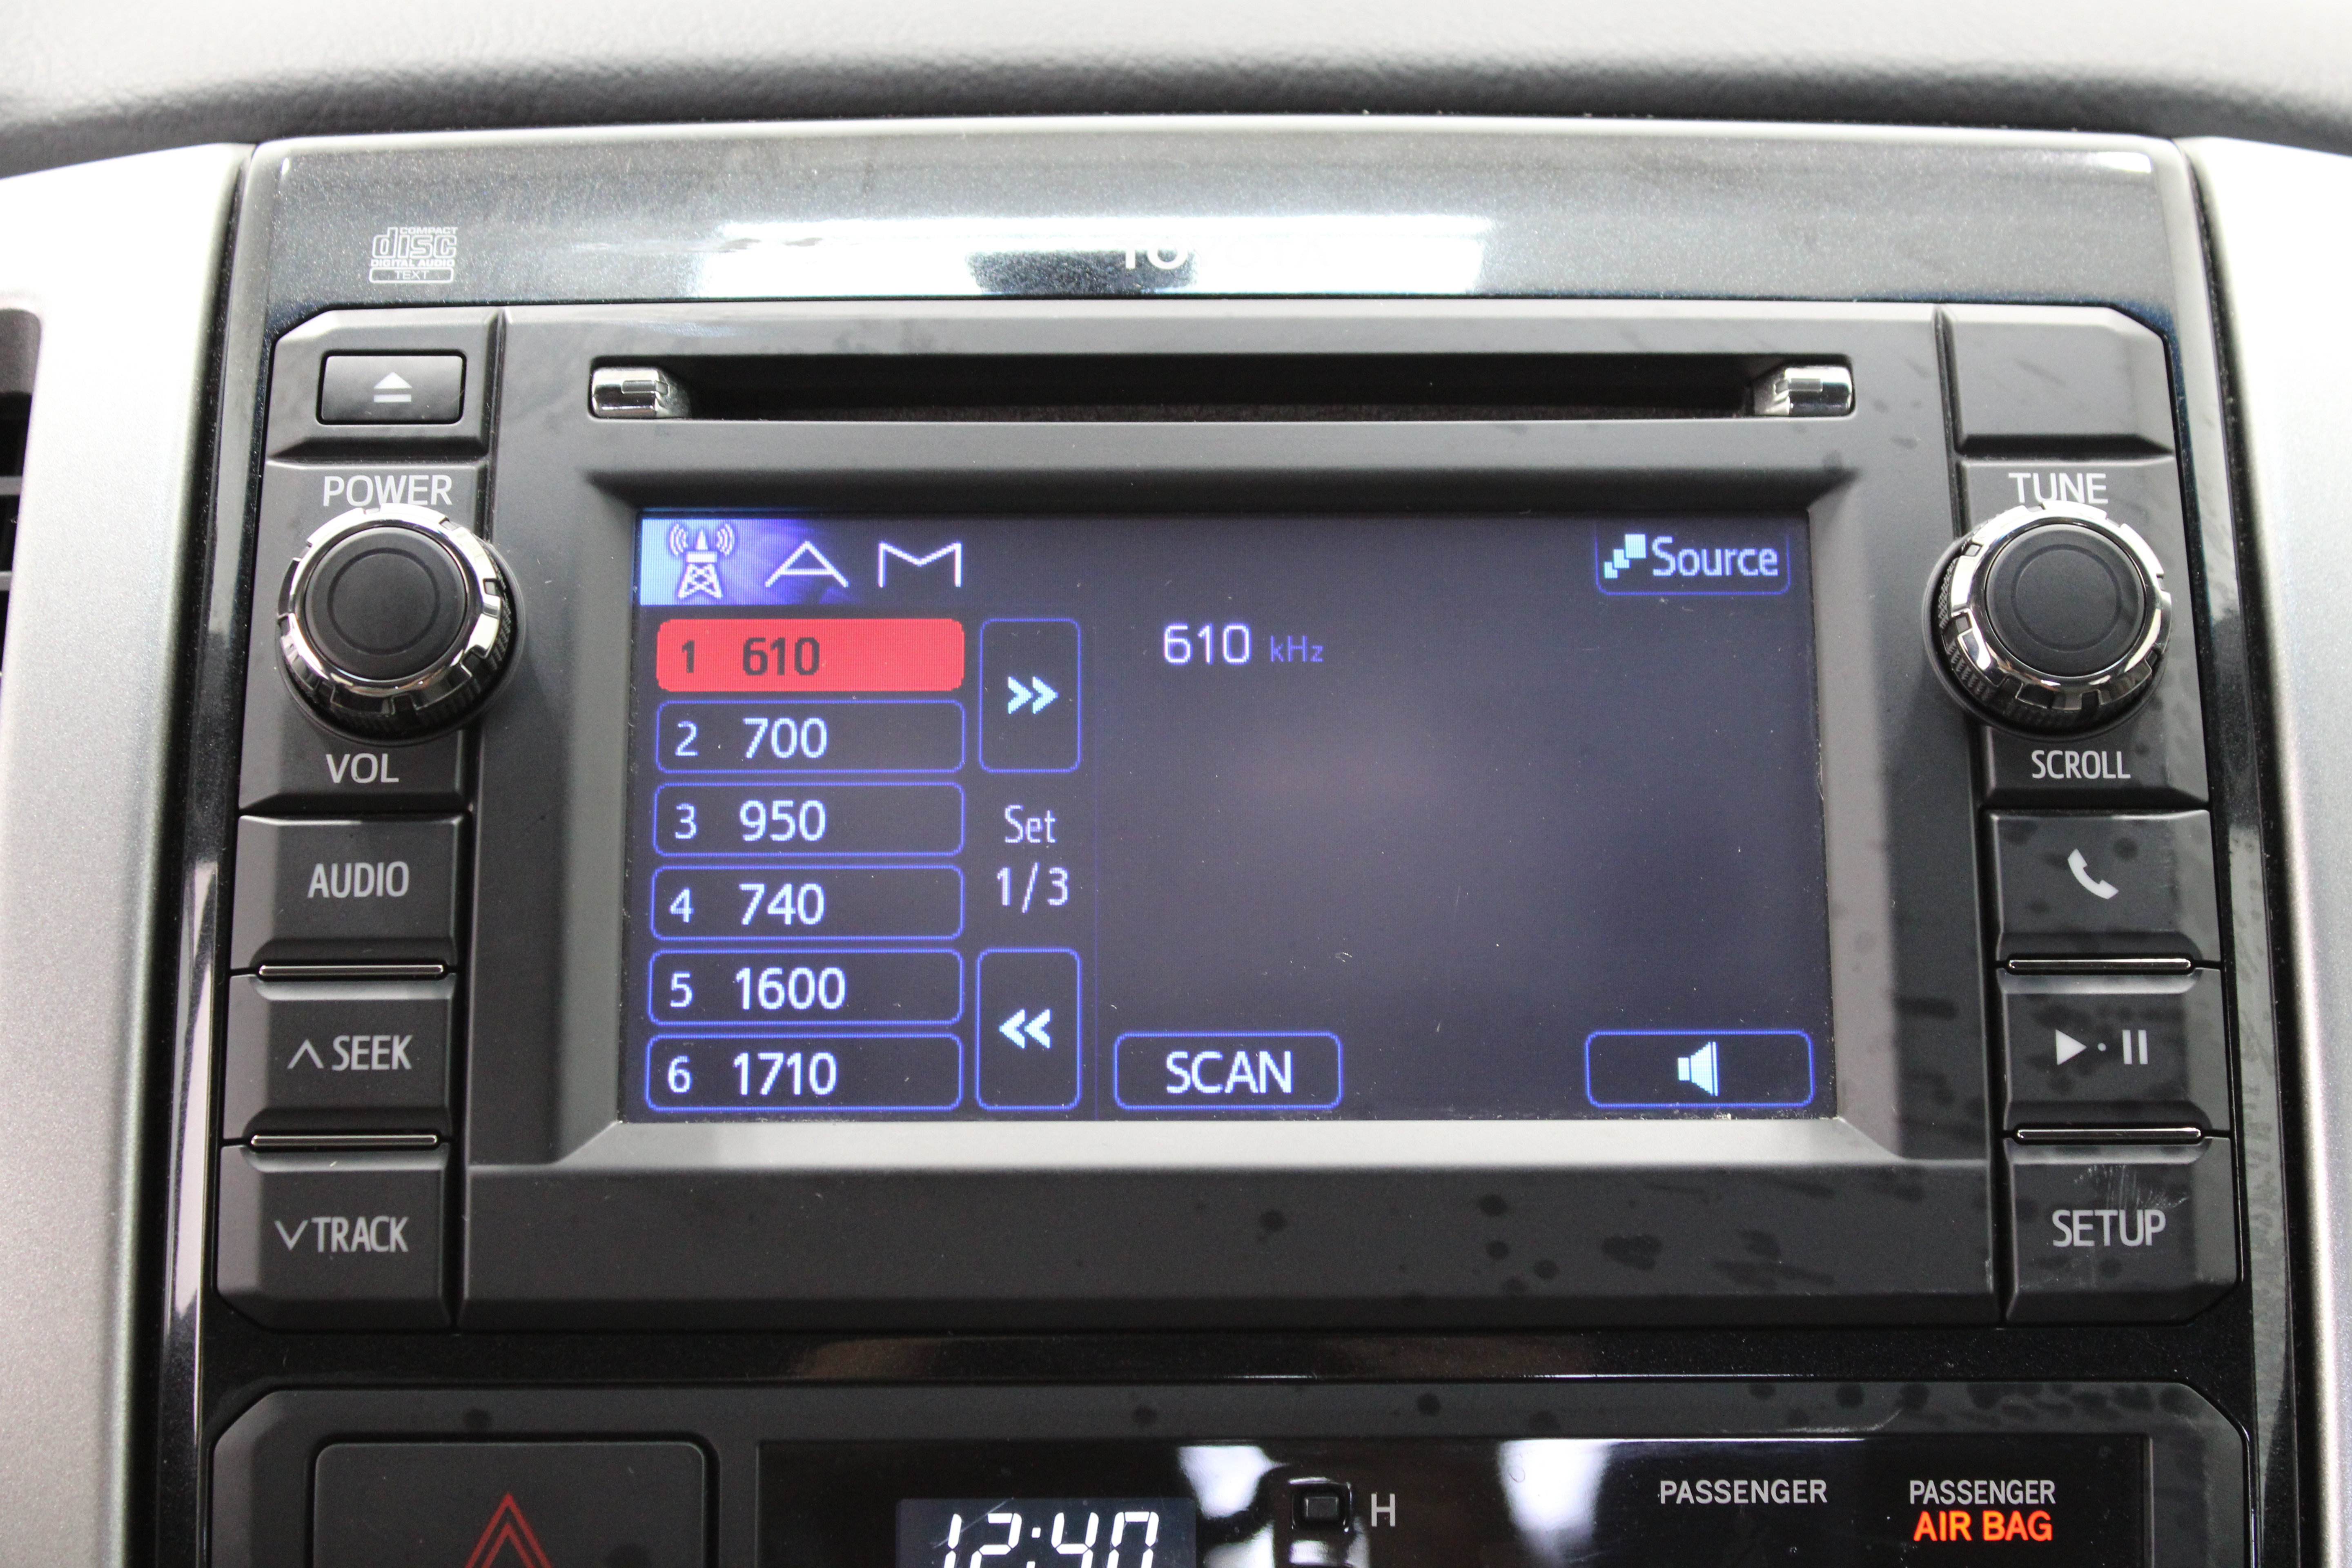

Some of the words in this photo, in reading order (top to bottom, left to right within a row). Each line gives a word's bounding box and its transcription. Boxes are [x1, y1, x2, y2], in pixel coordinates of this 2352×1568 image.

[372, 227, 457, 258] disc
[394, 270, 429, 280] TEXT
[323, 474, 452, 507] POWER
[2009, 473, 2108, 504] TUNE
[765, 541, 962, 587] AM
[1652, 536, 1779, 577] Source
[682, 640, 695, 674] 1
[742, 637, 820, 675] 610
[1163, 624, 1252, 665] 610
[1270, 635, 1323, 663] kHz
[675, 721, 698, 756] 2
[743, 718, 828, 758] 700
[326, 753, 399, 783] VOL
[2032, 750, 2131, 779] SCROLL
[675, 804, 697, 840] 3
[739, 801, 826, 842] 950
[1004, 805, 1056, 843] Set
[307, 861, 409, 898] AUDIO
[996, 862, 1069, 913] 1/3
[670, 888, 694, 922] 4
[739, 883, 825, 925] 740
[670, 973, 692, 1008] 5
[735, 968, 846, 1009] 1600
[332, 1035, 412, 1071] SEEK
[668, 1056, 691, 1094] 6
[733, 1052, 837, 1096] 1710
[1166, 1050, 1292, 1095] SCAN
[312, 1216, 408, 1252] TRACK
[2052, 1209, 2165, 1247] SETUP
[1371, 1493, 1396, 1526] H
[1660, 1480, 1827, 1504] PASSENGER
[1910, 1480, 2056, 1504] PASSENGER
[944, 1511, 1159, 1568] 12:40
[1913, 1510, 1971, 1541] AIR
[1983, 1510, 2053, 1541] BAG
